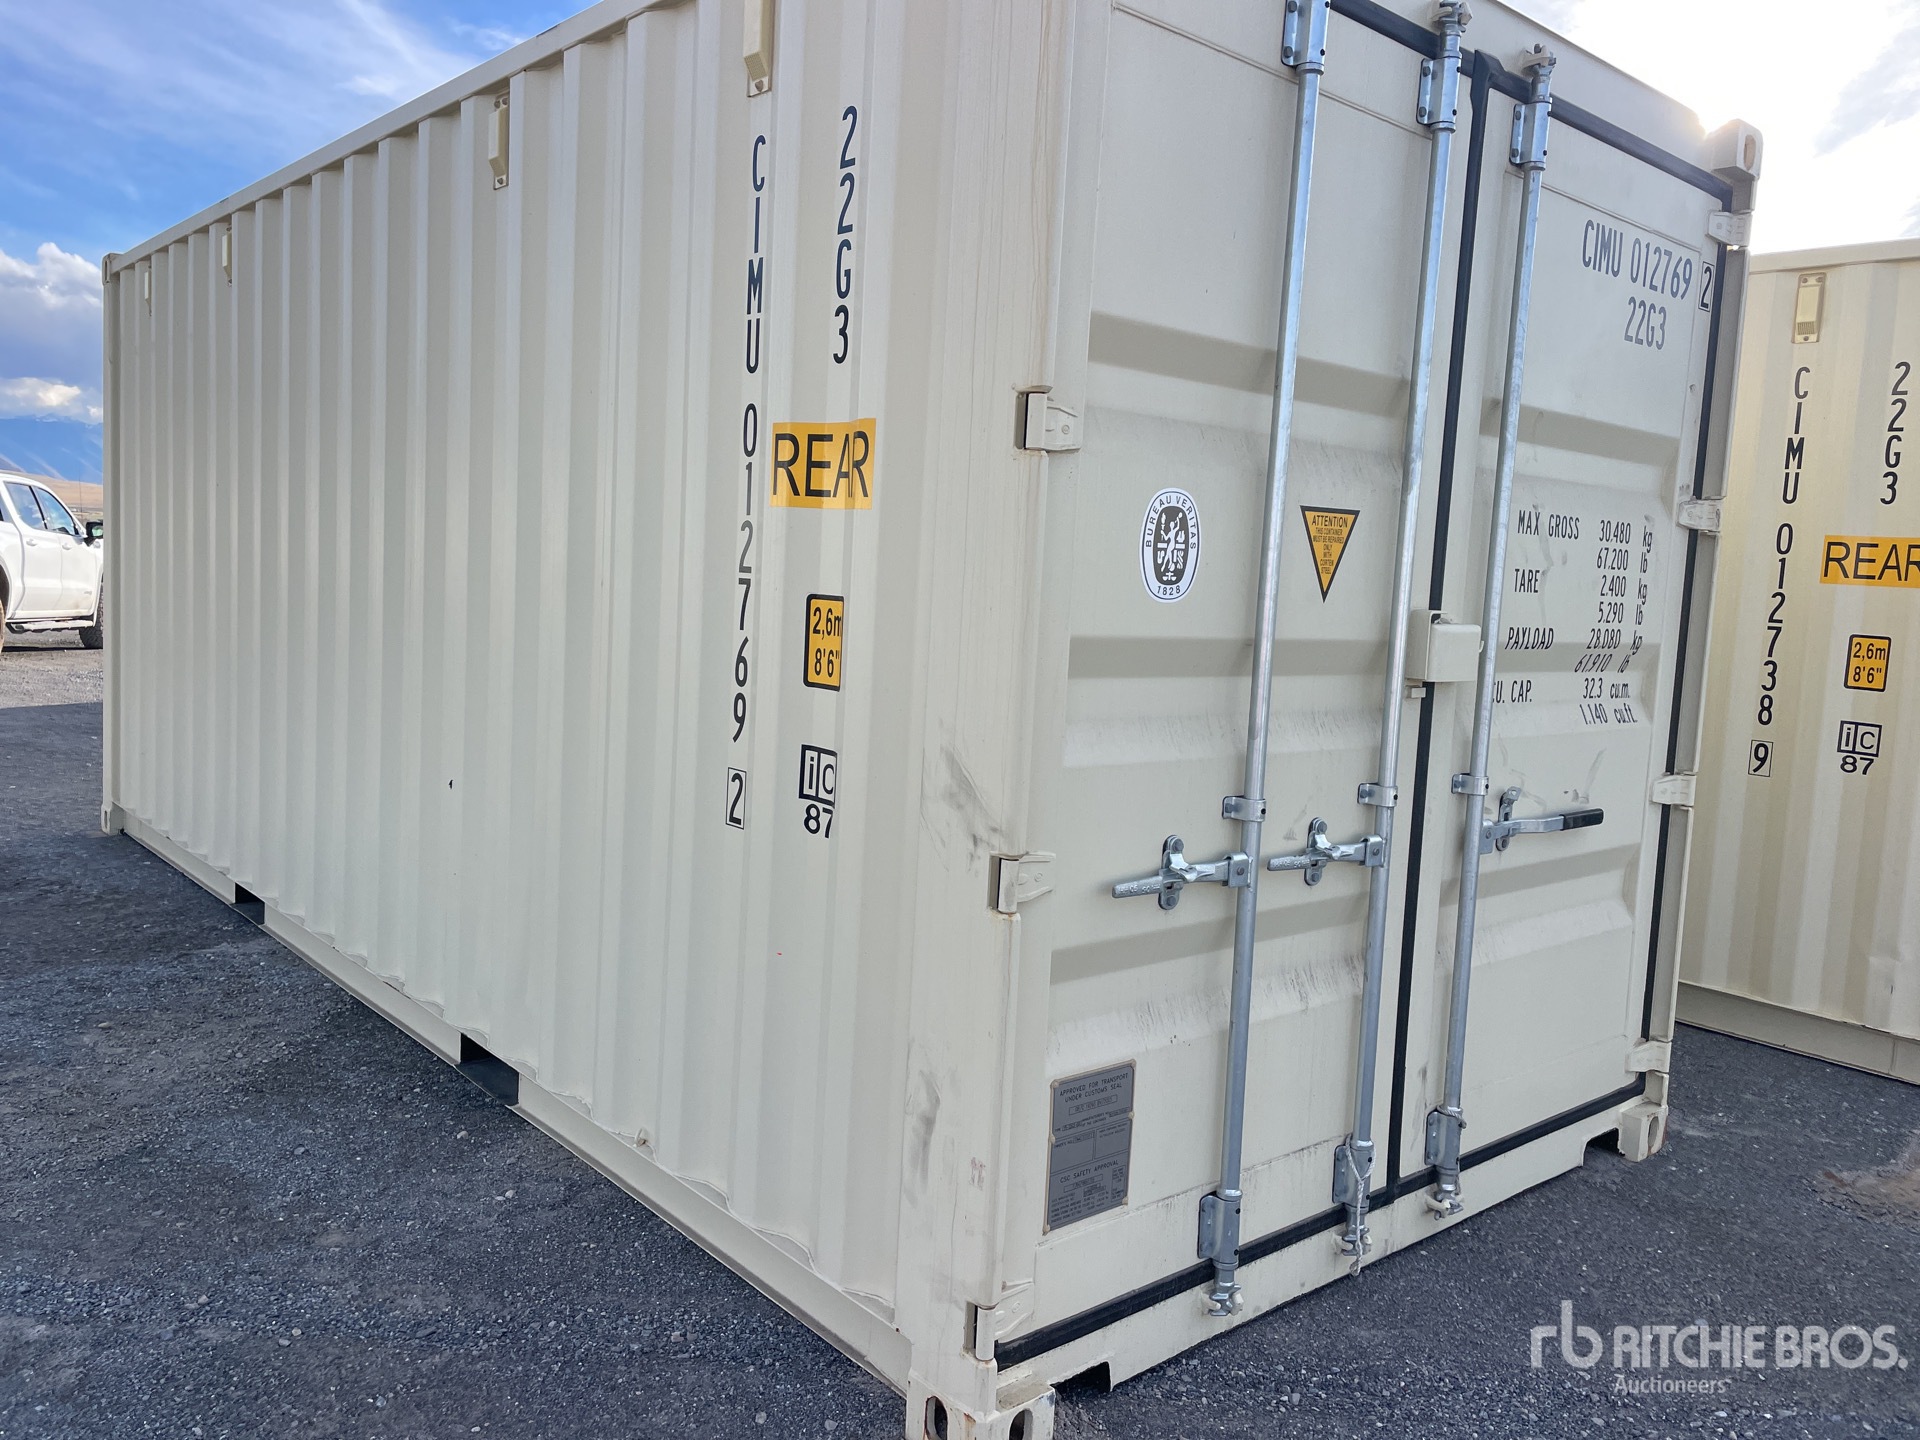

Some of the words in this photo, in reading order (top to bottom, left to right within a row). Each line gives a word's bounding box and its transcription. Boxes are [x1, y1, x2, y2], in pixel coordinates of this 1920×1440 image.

[833, 105, 858, 364] 22G3
[746, 134, 766, 374] CIMU
[1582, 219, 1623, 278] CIMU
[1630, 237, 1693, 300] 012769
[1700, 265, 1712, 309] 2
[1624, 296, 1667, 350] 22G3
[1782, 366, 1811, 505] CIMU
[1880, 360, 1911, 505] 22G3
[773, 430, 870, 498] REAR
[1145, 495, 1172, 548] BUREAU
[1175, 495, 1197, 550] VERITAS
[1312, 515, 1348, 528] ATTENTION
[1517, 510, 1541, 536] MAX
[1548, 513, 1580, 540] GROSS
[1642, 526, 1653, 553] kg
[732, 403, 758, 743] 012769
[1639, 552, 1648, 573] lb
[1157, 584, 1181, 596] 1828
[1514, 568, 1541, 594] TARE
[1637, 578, 1648, 605] kg
[1635, 604, 1644, 625] lb
[1757, 522, 1794, 726] 012738
[1504, 627, 1554, 650] PAYLOAD
[1630, 630, 1643, 655] kg
[1617, 654, 1631, 673] lb
[1511, 680, 1532, 703] CAP.
[1583, 677, 1603, 699] 32.3
[1752, 742, 1769, 773] 9
[1839, 754, 1875, 776] 87
[728, 772, 744, 825] 2
[803, 803, 834, 839] 87
[1060, 1084, 1086, 1097] APPROVED
[1064, 1093, 1082, 1103] UNDER
[1059, 1174, 1071, 1184] CSC
[1073, 1168, 1091, 1179] SAFETY
[1093, 1160, 1119, 1172] APPROVAL
